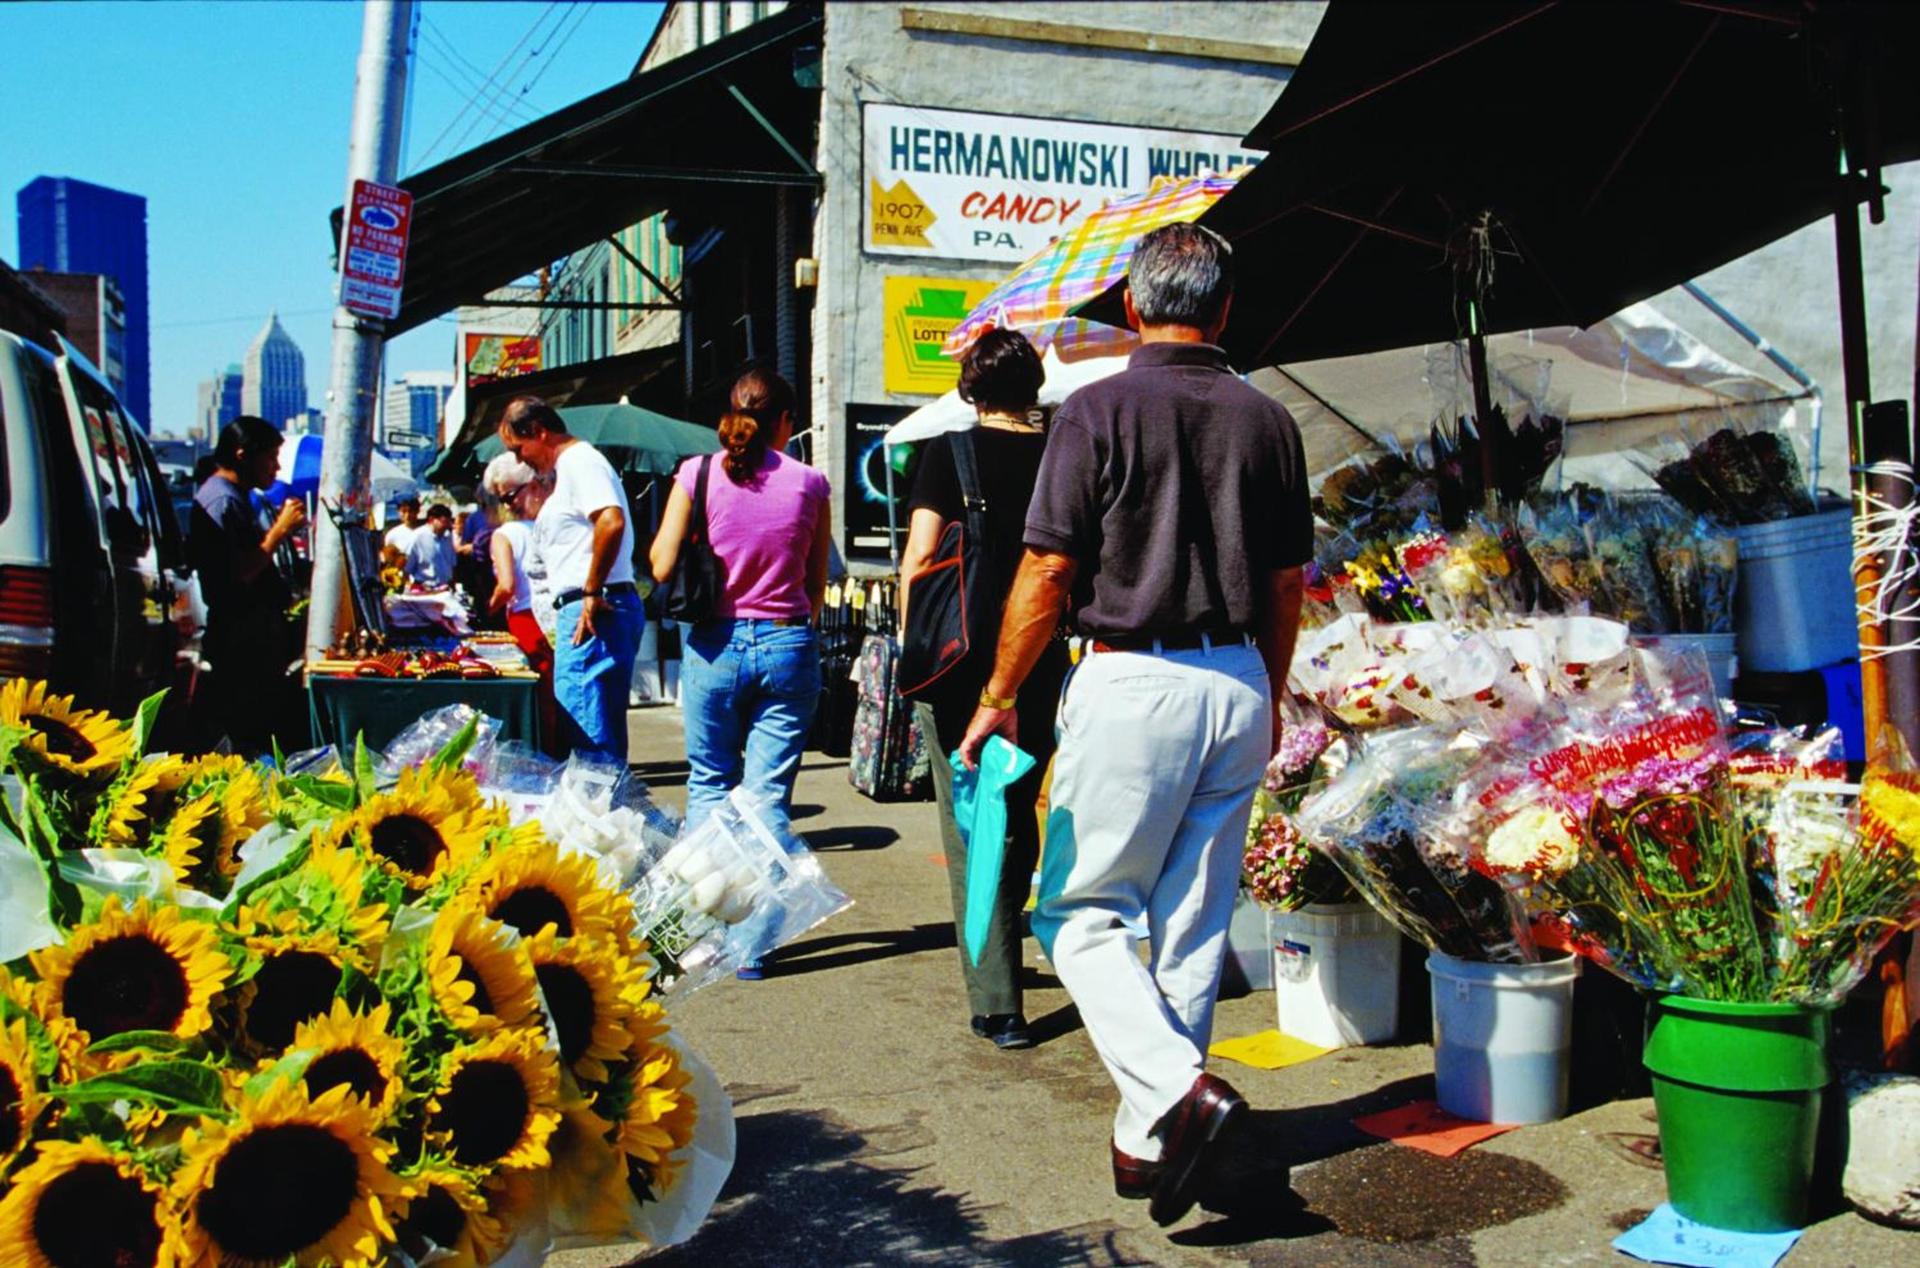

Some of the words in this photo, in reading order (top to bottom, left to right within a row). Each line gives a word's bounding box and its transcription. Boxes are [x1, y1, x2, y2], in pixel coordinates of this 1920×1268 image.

[890, 126, 1129, 188] HERMANOWSKI
[1147, 147, 1262, 184] WHO
[879, 202, 924, 219] 1907
[960, 191, 1081, 225] CANDY
[973, 230, 1023, 250] PA.
[913, 327, 951, 342] LOTT
